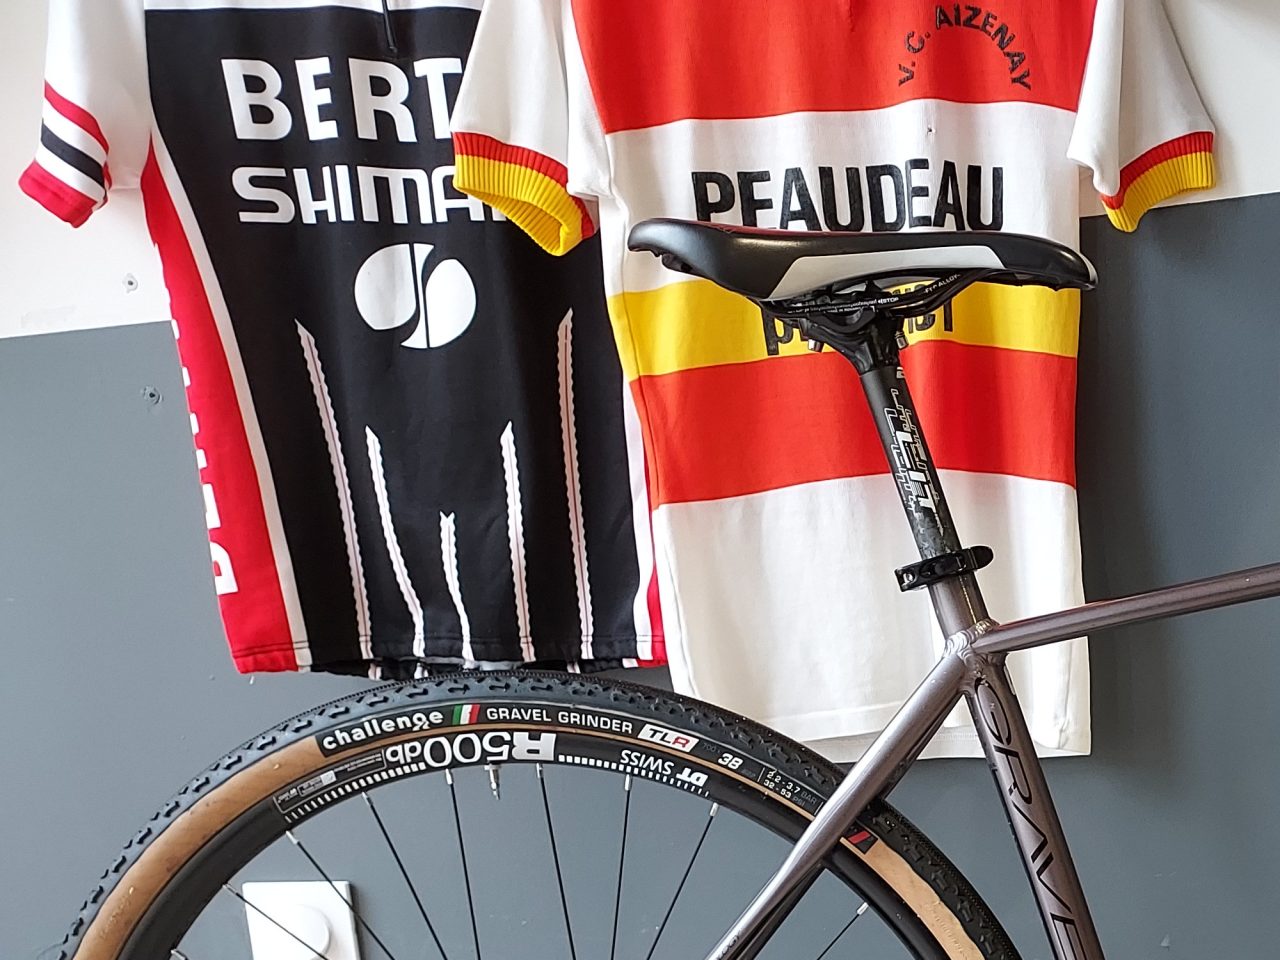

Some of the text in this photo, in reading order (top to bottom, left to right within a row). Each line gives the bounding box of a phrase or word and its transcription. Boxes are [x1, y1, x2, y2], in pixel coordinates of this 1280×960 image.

[935, 3, 1031, 91] AIZENAY
[220, 56, 463, 143] BERT
[231, 164, 506, 225] SHIMA
[691, 158, 1004, 233] PEAUDEAU
[322, 708, 444, 750] challenge
[486, 704, 551, 722] GRAVEL
[557, 711, 633, 734] GRINDER
[647, 727, 692, 749] TLR
[717, 752, 743, 770] 38
[620, 749, 708, 788] DT SWISS
